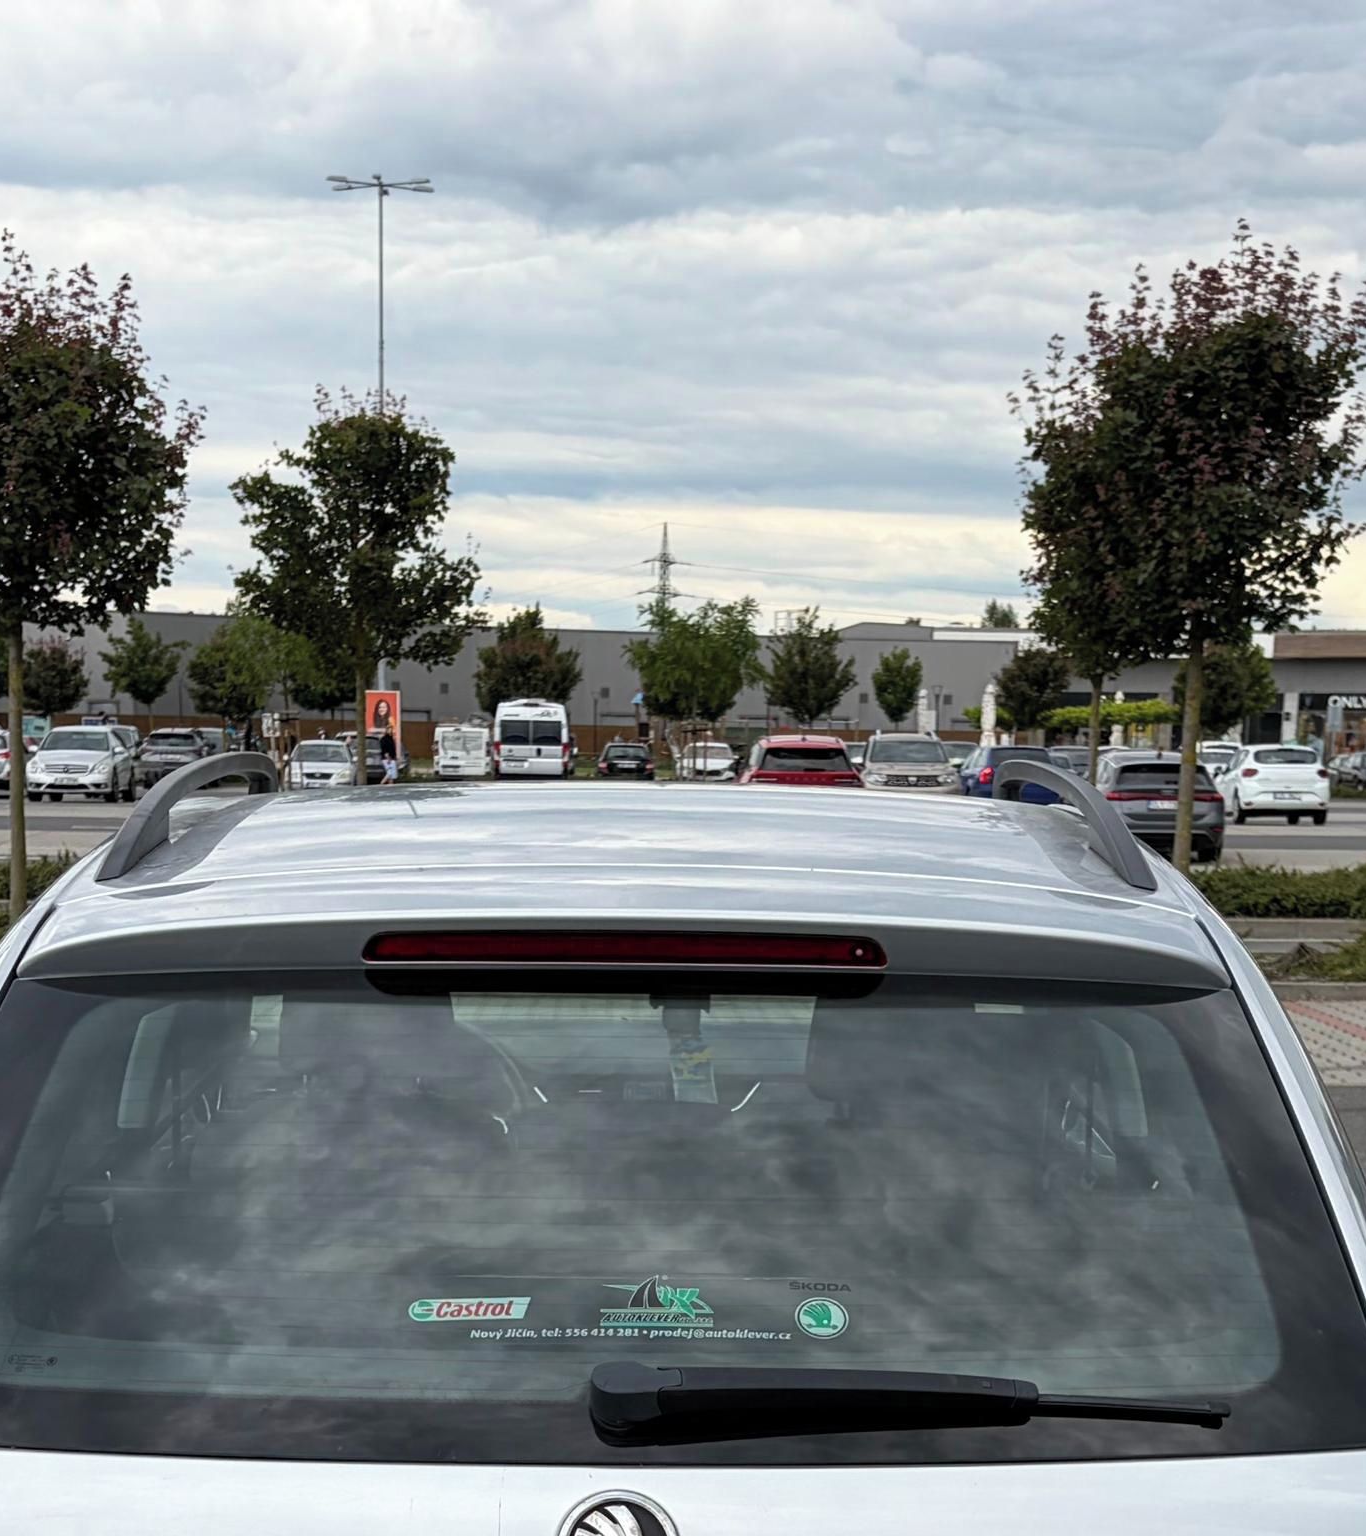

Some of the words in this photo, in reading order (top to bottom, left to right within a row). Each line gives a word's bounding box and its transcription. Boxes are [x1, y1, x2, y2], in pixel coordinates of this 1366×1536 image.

[436, 1300, 514, 1318] Castrol
[470, 1328, 503, 1340] Nový
[504, 1327, 538, 1339] Jičín,
[541, 1327, 563, 1338] tel:
[565, 1327, 588, 1338] 556
[590, 1327, 615, 1338] 414
[616, 1327, 639, 1338] 281
[649, 1328, 792, 1341] prodej@autoklever.cz
